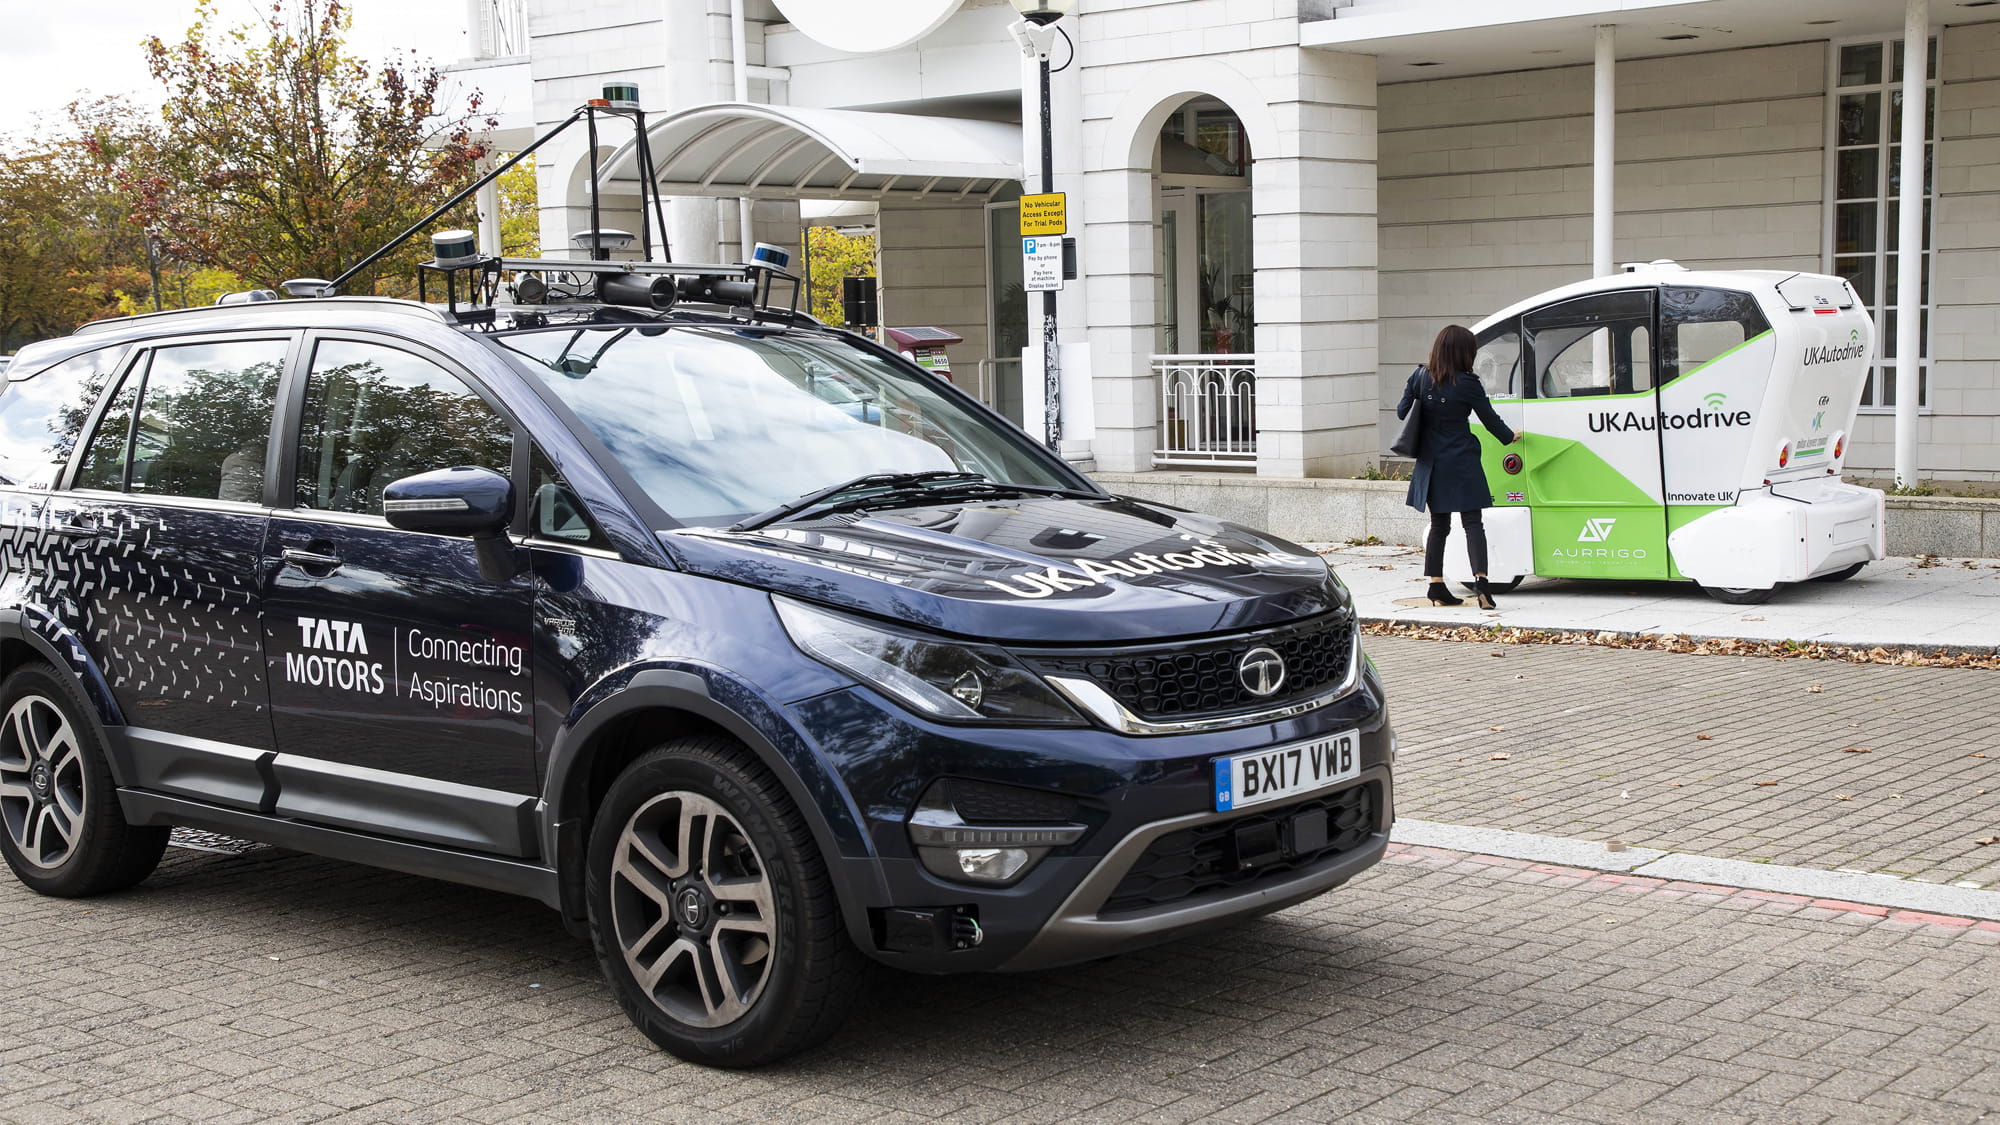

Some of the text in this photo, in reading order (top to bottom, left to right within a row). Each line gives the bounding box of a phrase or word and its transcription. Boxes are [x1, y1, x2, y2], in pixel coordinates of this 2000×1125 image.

[1034, 200, 1061, 208] Vehicular
[1803, 342, 1864, 366] UKAutodrive
[1588, 406, 1751, 433] UKAutodrive
[1667, 491, 1734, 501] Innovate UK
[984, 536, 1308, 599] UKAutodrive
[1552, 548, 1647, 559] AURRIGO
[297, 616, 369, 655] TATA
[408, 628, 522, 677] Connecting
[286, 652, 385, 695] MOTORS
[409, 671, 523, 714] Aspirations
[1242, 736, 1353, 798] BX17 VWB
[1218, 790, 1230, 803] GB
